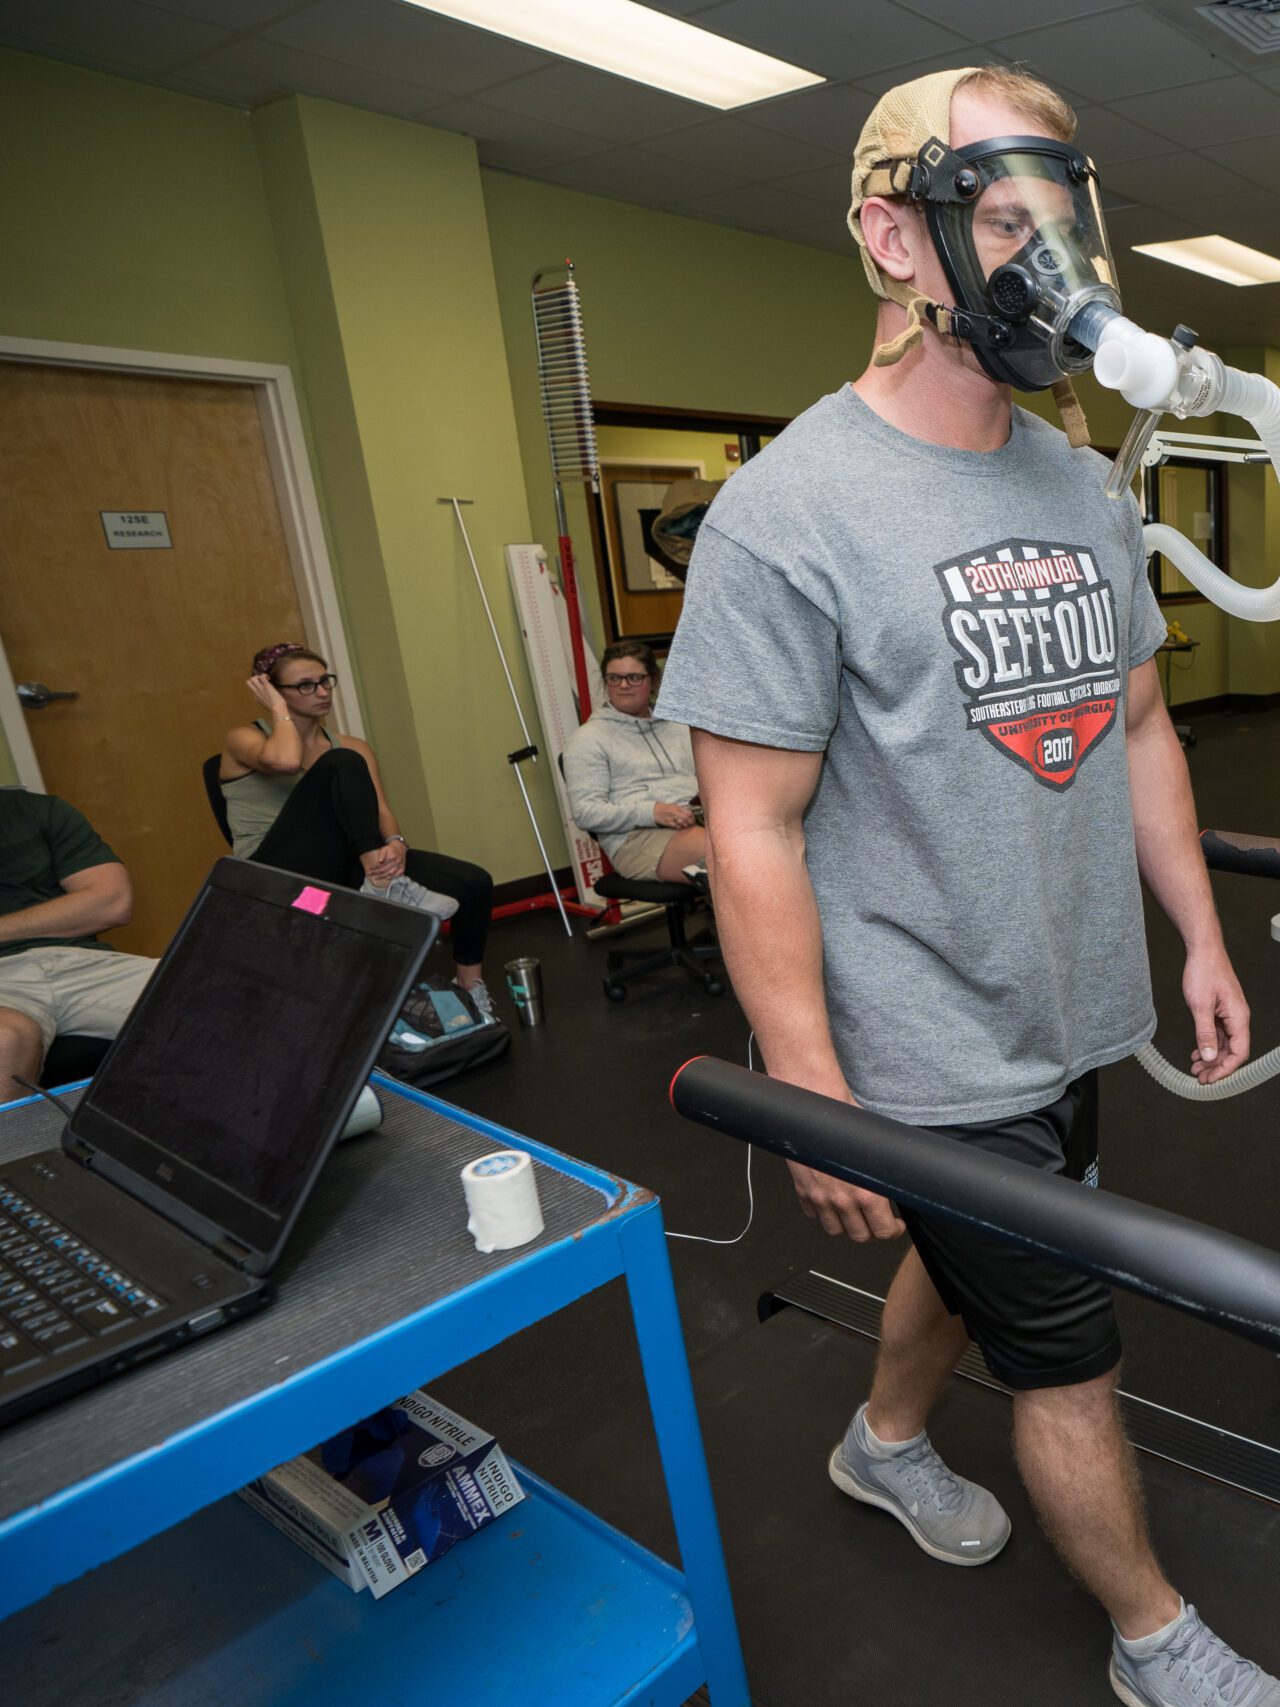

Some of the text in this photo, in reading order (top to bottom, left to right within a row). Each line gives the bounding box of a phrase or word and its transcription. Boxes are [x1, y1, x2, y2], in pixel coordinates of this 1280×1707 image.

[964, 554, 1084, 595] 20TH ANNUAL
[950, 587, 1116, 689] SEFFOW
[1037, 690, 1070, 708] FOOTBALL
[1059, 712, 1073, 723] OF
[1043, 736, 1073, 765] 2017
[398, 1396, 475, 1447] NDIGO NITRILE
[452, 1465, 491, 1525] AMMEX
[478, 1467, 504, 1510] NITRILE
[487, 1461, 514, 1503] INDIGO
[362, 1519, 383, 1542] M
[348, 1532, 361, 1550] MADE
[361, 1555, 378, 1585] MALAYSIA
[376, 1542, 396, 1574] 100 GLOVES
